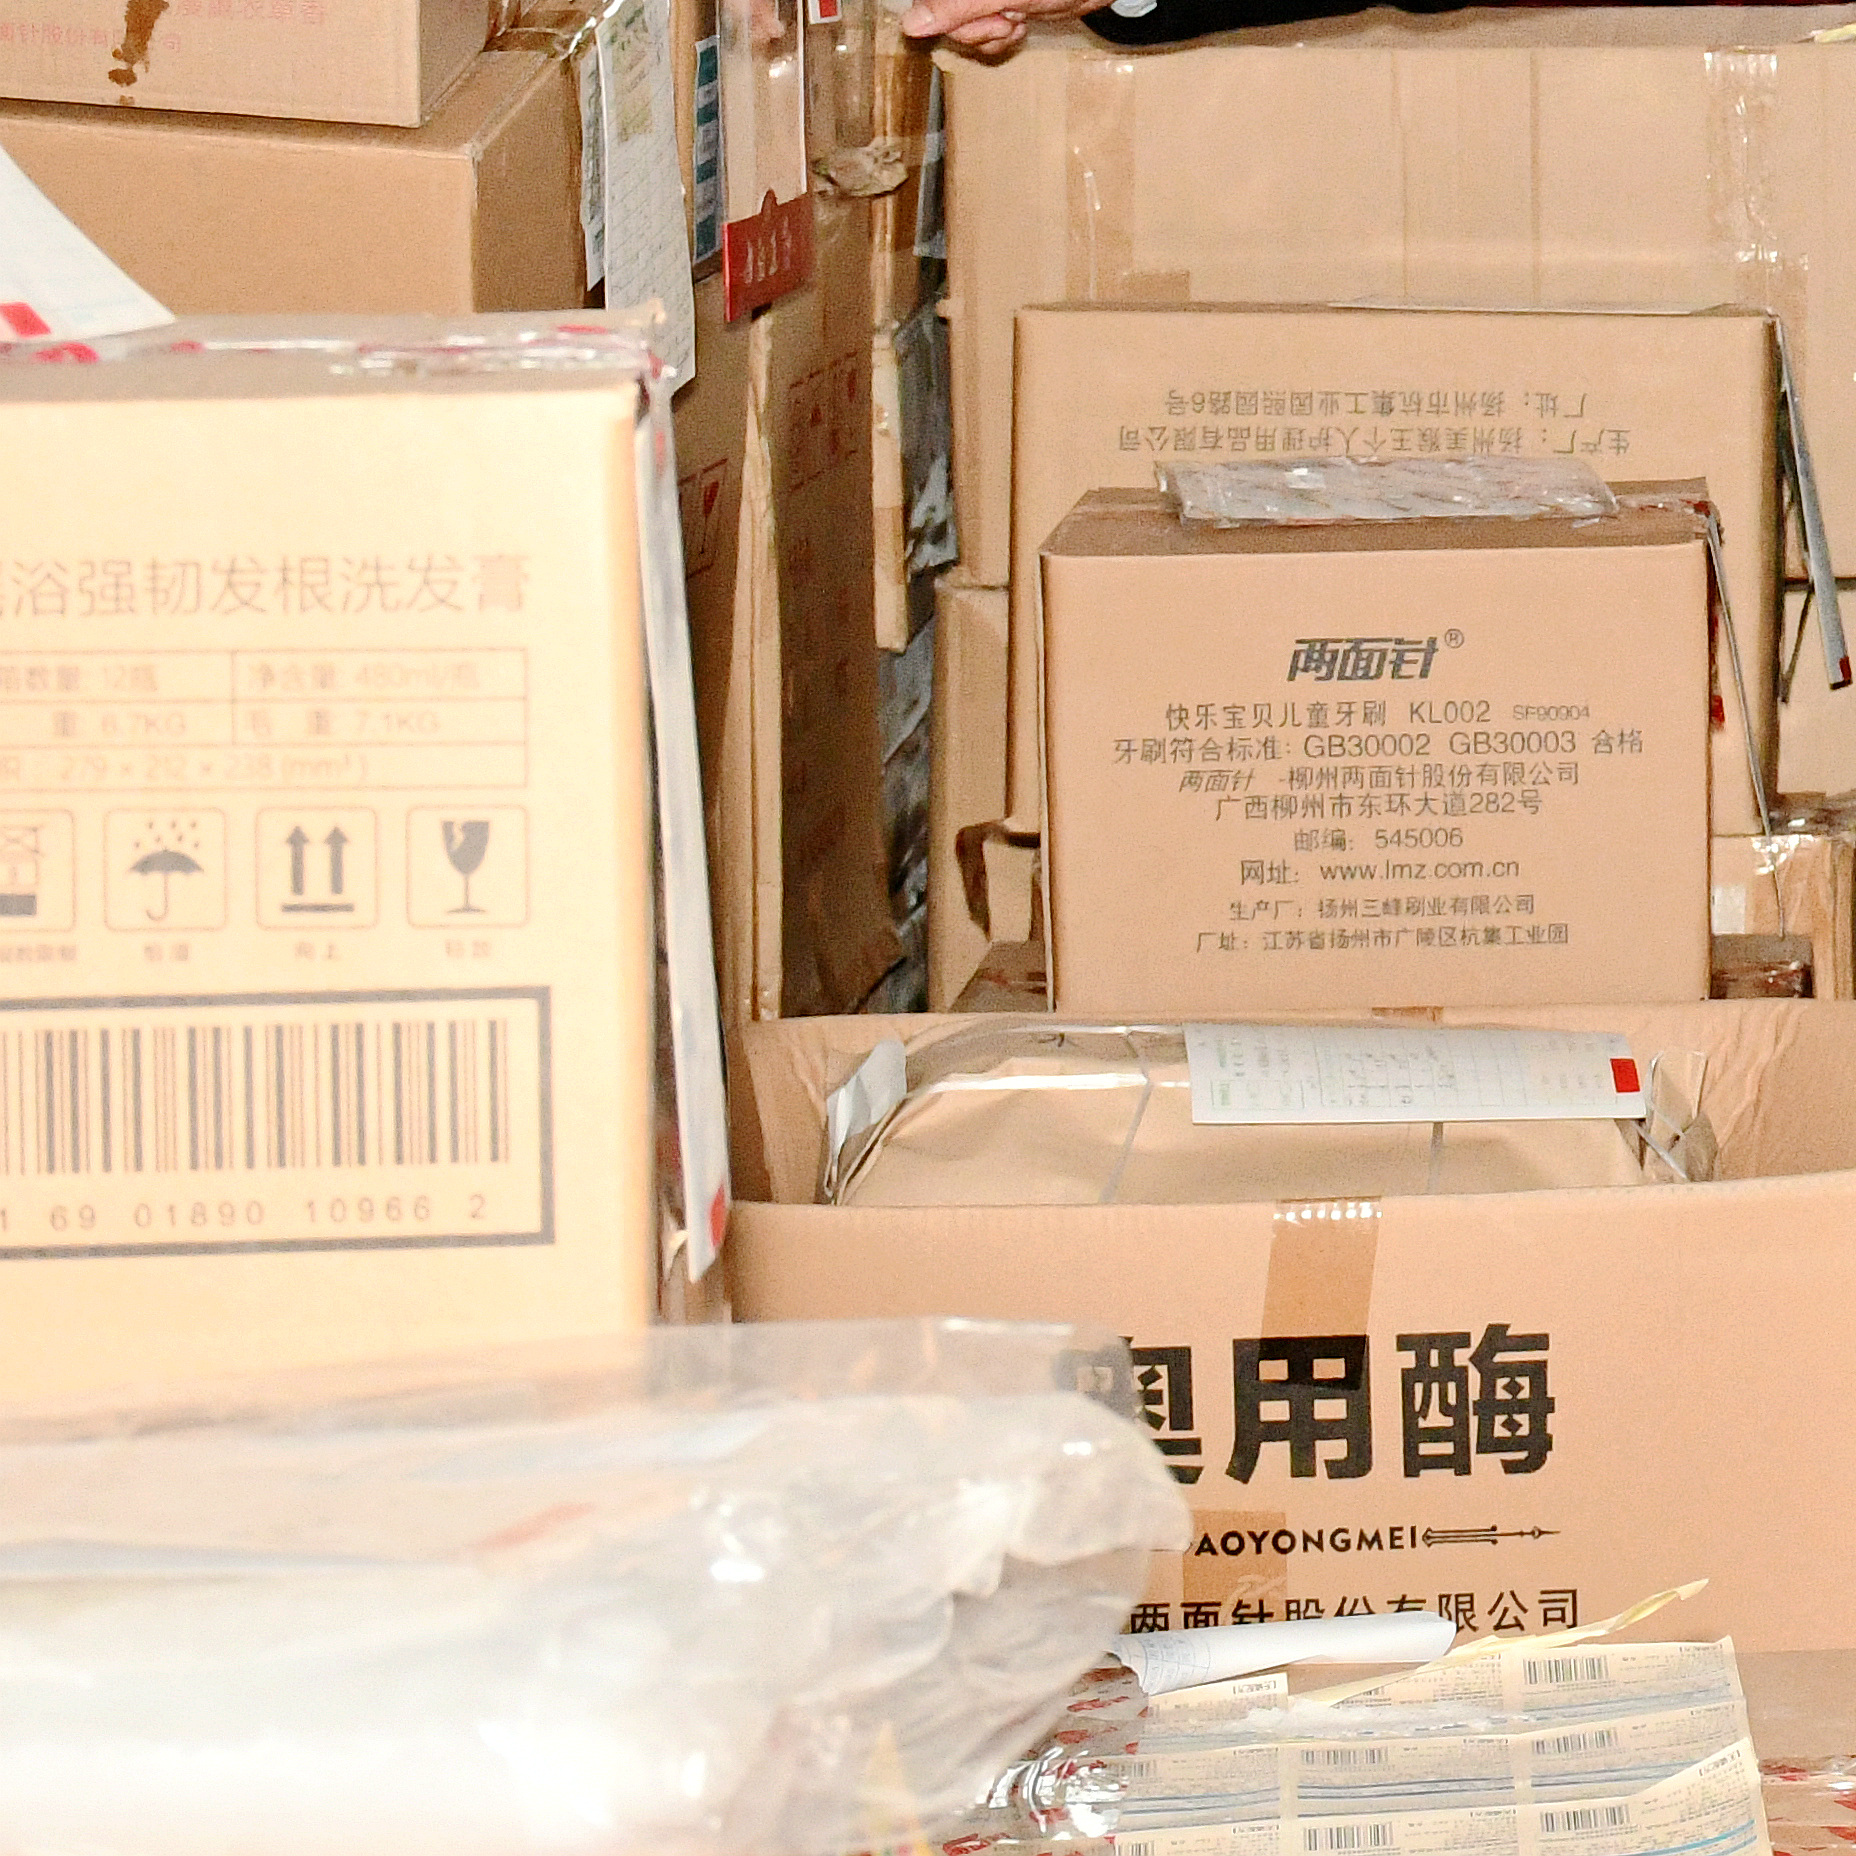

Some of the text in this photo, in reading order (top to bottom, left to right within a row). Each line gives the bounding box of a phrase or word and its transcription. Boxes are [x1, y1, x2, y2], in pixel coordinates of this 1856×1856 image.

[0, 552, 531, 617] 浴强韧发根洗发膏
[1288, 637, 1438, 681] 两面针
[1166, 701, 1386, 730] 快乐宝贝儿童牙刷
[1410, 700, 1490, 723] KL002
[1304, 733, 1430, 758] GB30002
[1449, 731, 1576, 755] GB30003
[1216, 789, 1541, 821] 广西柳州市东环大道282号
[1375, 827, 1463, 848] 545006
[1320, 860, 1519, 881] www.lmz.com.cn
[1195, 1524, 1419, 1558] AOYONGMEI
